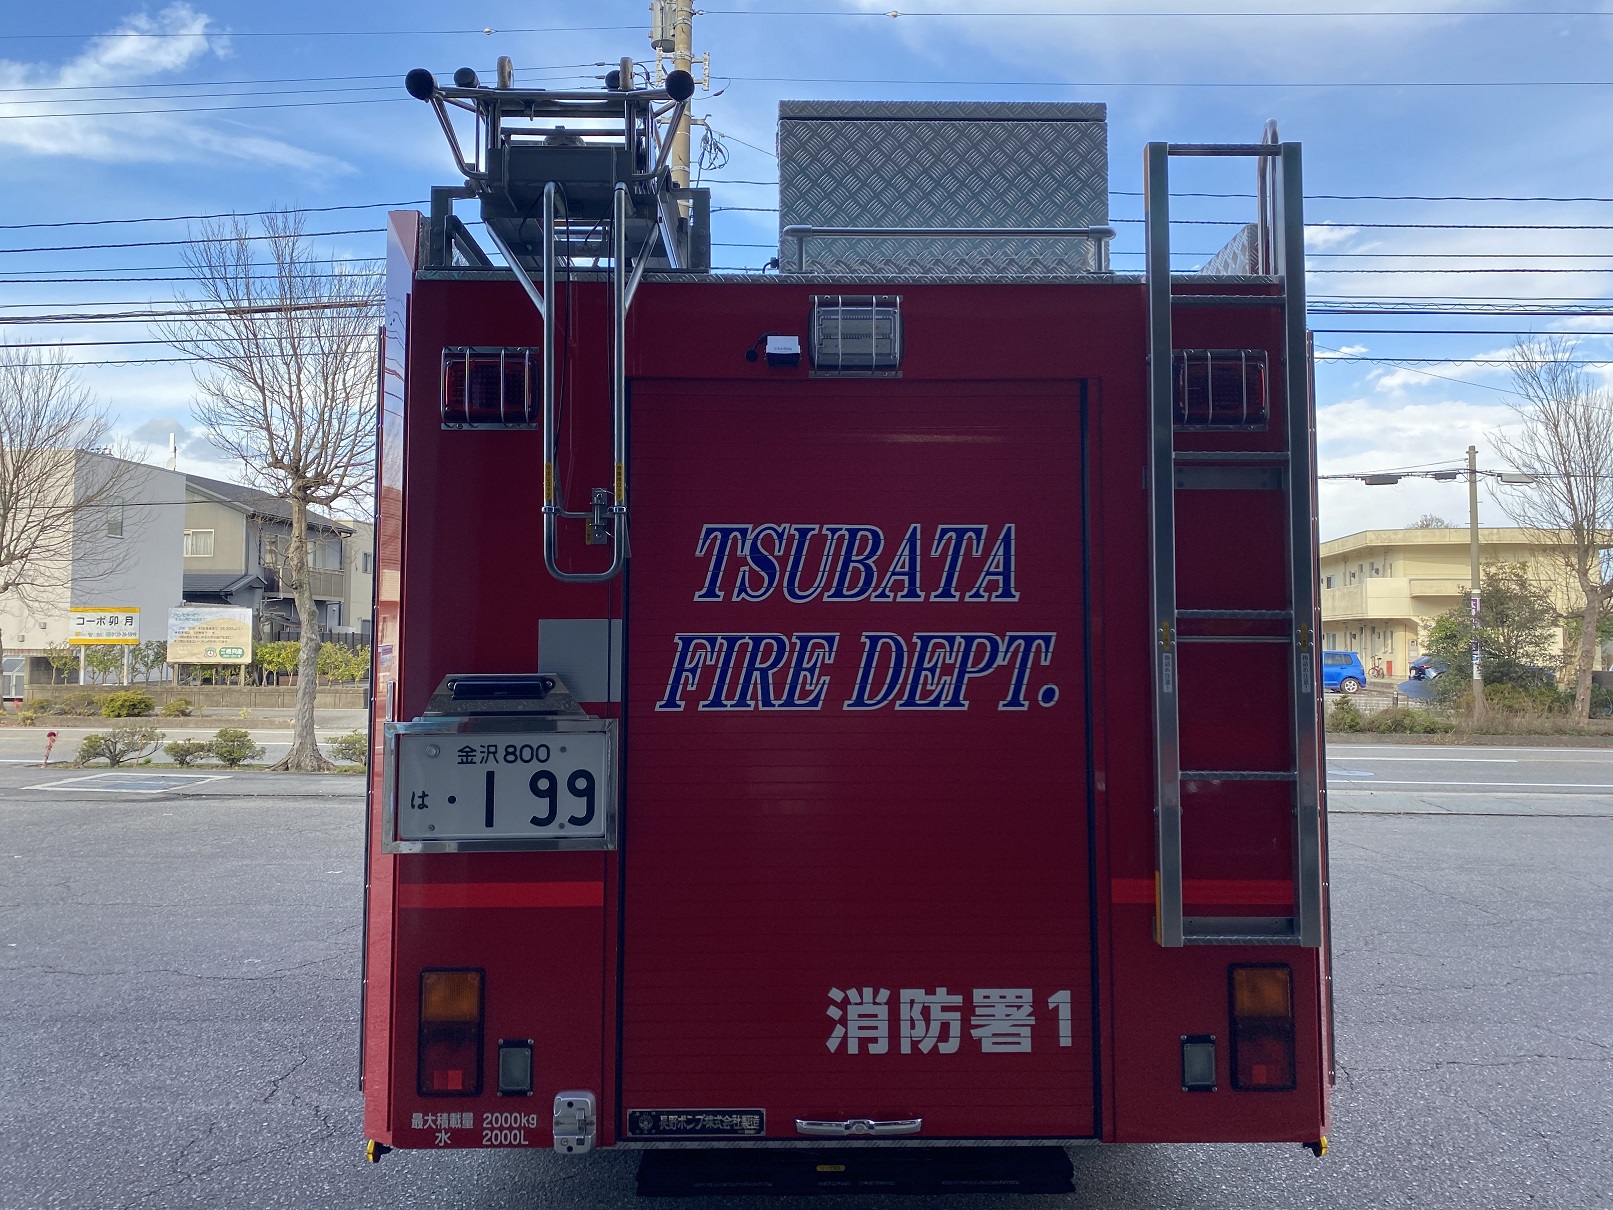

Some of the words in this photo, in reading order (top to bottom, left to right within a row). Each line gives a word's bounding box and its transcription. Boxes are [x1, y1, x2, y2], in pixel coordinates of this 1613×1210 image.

[693, 523, 1020, 603] TSUBATA
[655, 632, 840, 711] FIRE
[843, 632, 1060, 711] DEPT.
[410, 790, 430, 810] は
[411, 1112, 474, 1129] 最大積載量
[482, 1112, 537, 1129] 2000kg
[434, 1129, 451, 1146] 水
[482, 1129, 529, 1145] 2000L
